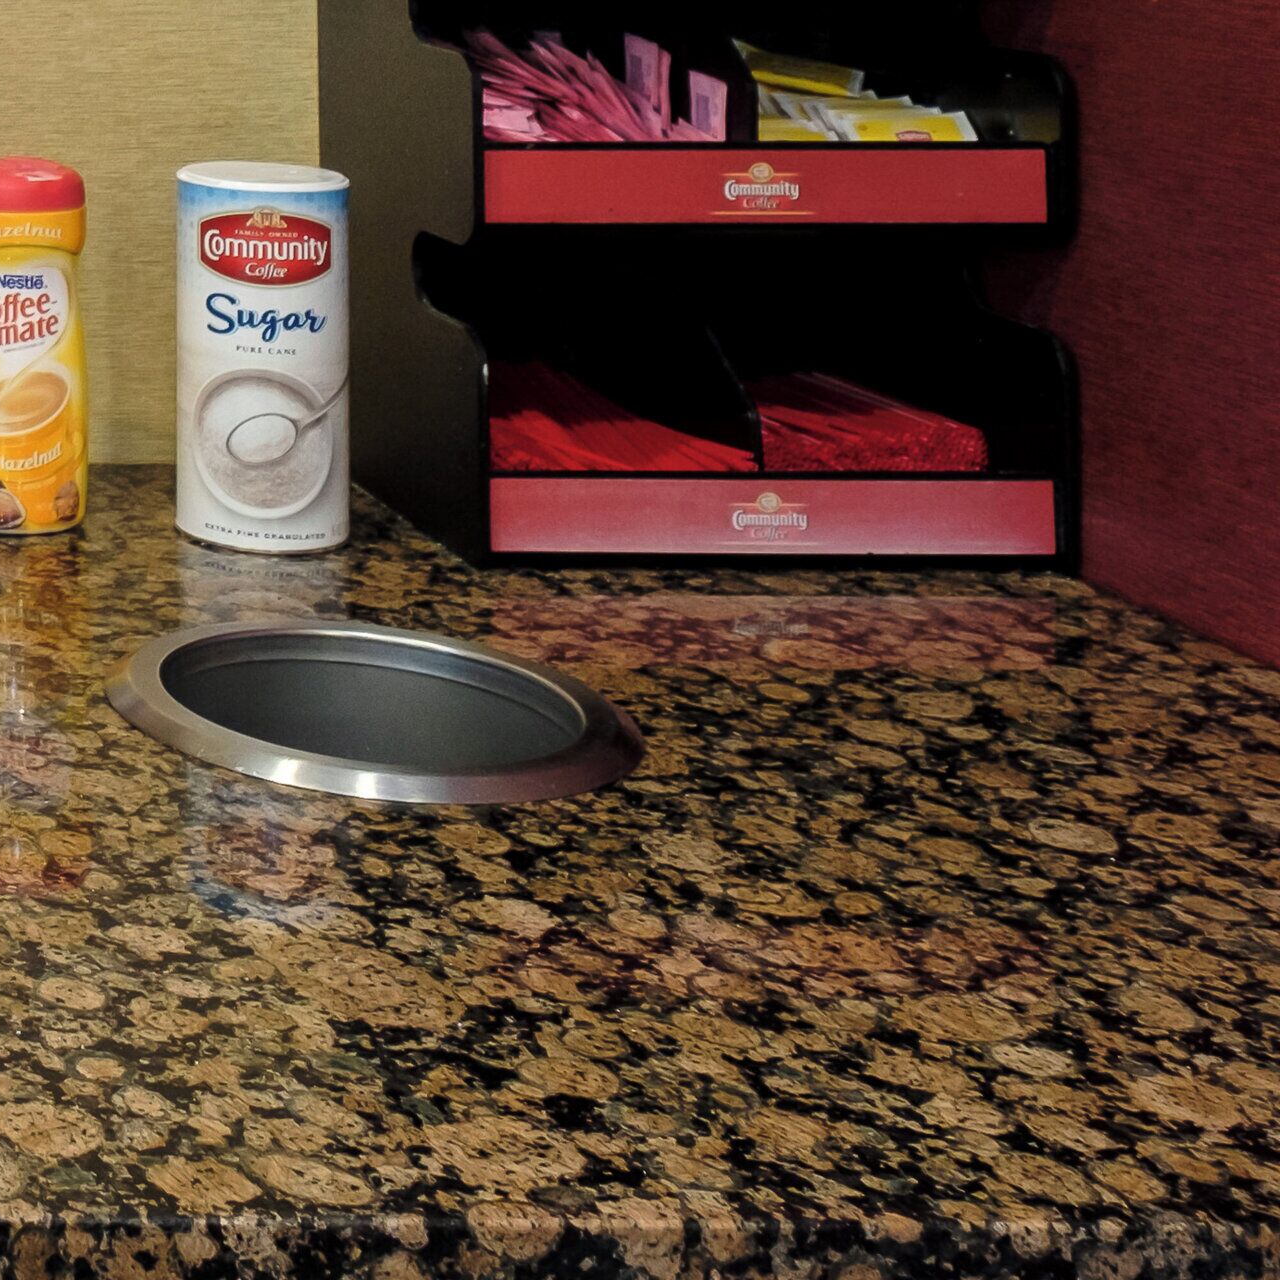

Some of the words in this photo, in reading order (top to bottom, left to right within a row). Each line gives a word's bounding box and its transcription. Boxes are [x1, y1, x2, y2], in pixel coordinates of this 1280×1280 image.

[724, 179, 799, 200] Community
[204, 229, 327, 265] Community
[245, 262, 287, 279] Coffee
[206, 293, 328, 343] Sugar
[236, 345, 262, 353] PURE
[732, 509, 808, 532] Community
